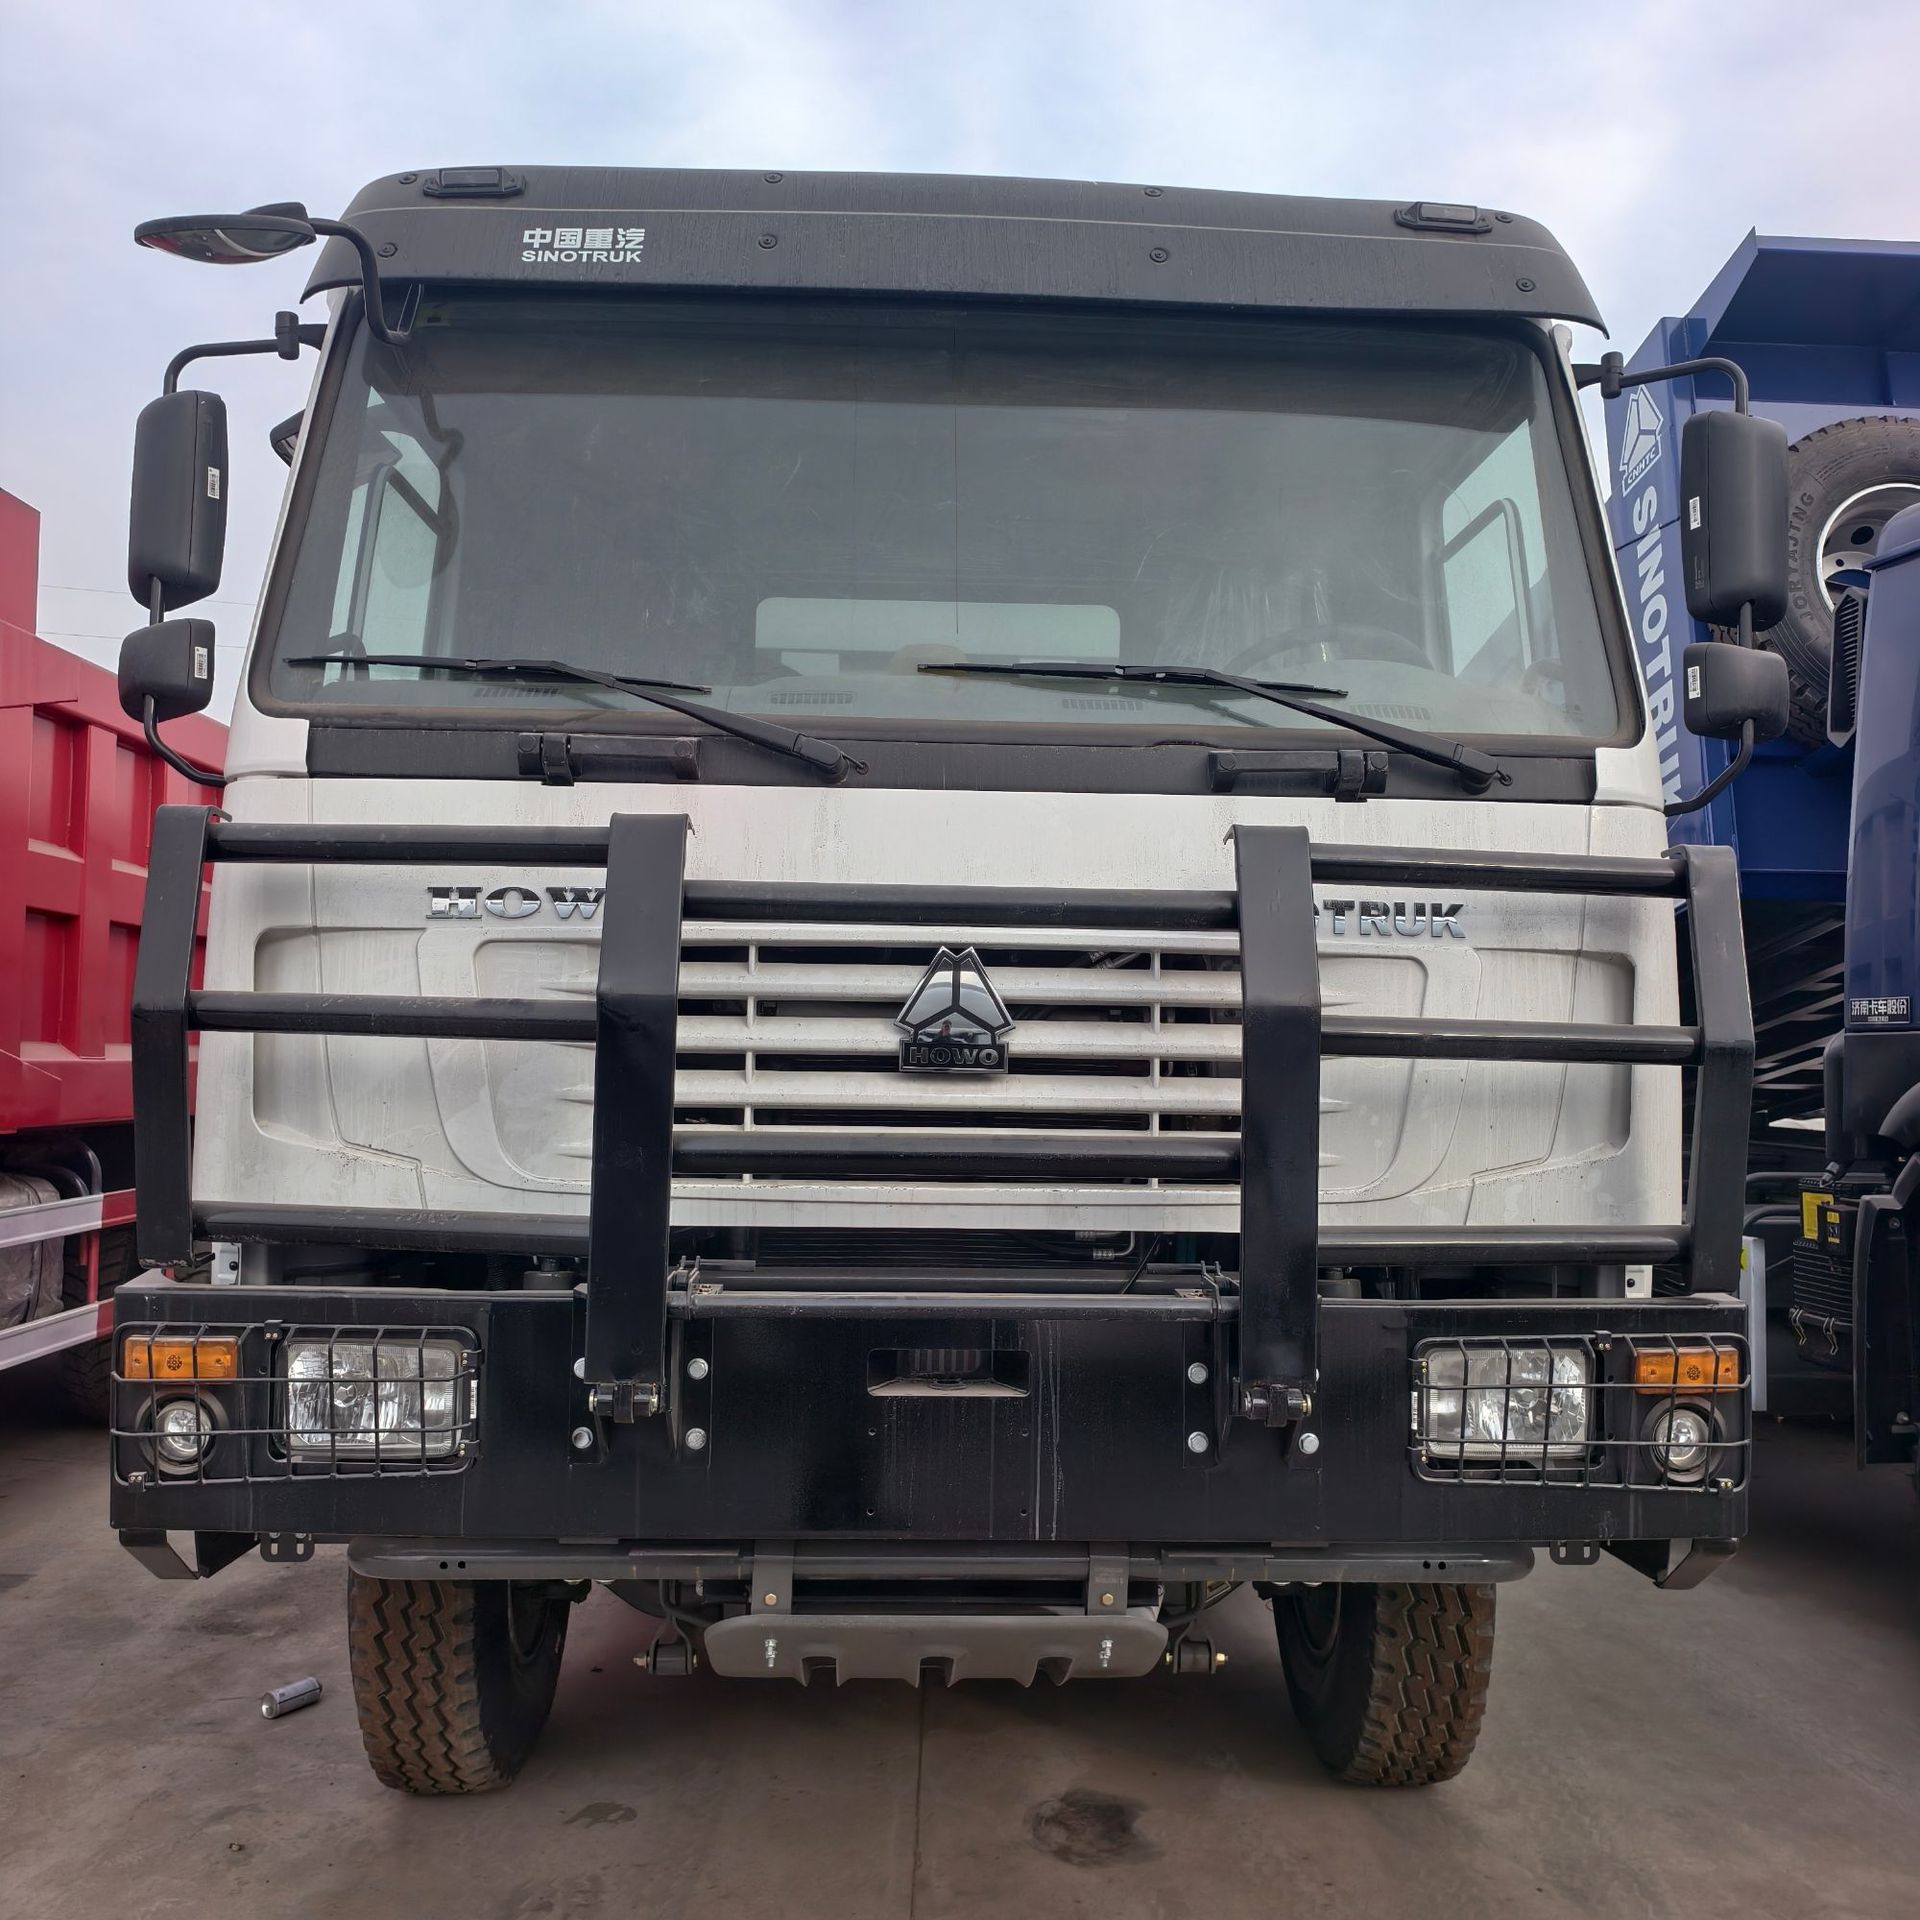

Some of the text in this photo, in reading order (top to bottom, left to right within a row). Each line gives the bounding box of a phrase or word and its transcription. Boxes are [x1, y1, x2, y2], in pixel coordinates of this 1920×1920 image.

[523, 228, 646, 249] 中国重汽
[522, 250, 642, 263] SINOTRUK
[1627, 446, 1656, 484] CNHTC
[425, 886, 607, 920] HOW
[1313, 900, 1466, 939] TRUK
[909, 1046, 999, 1065] HOWO
